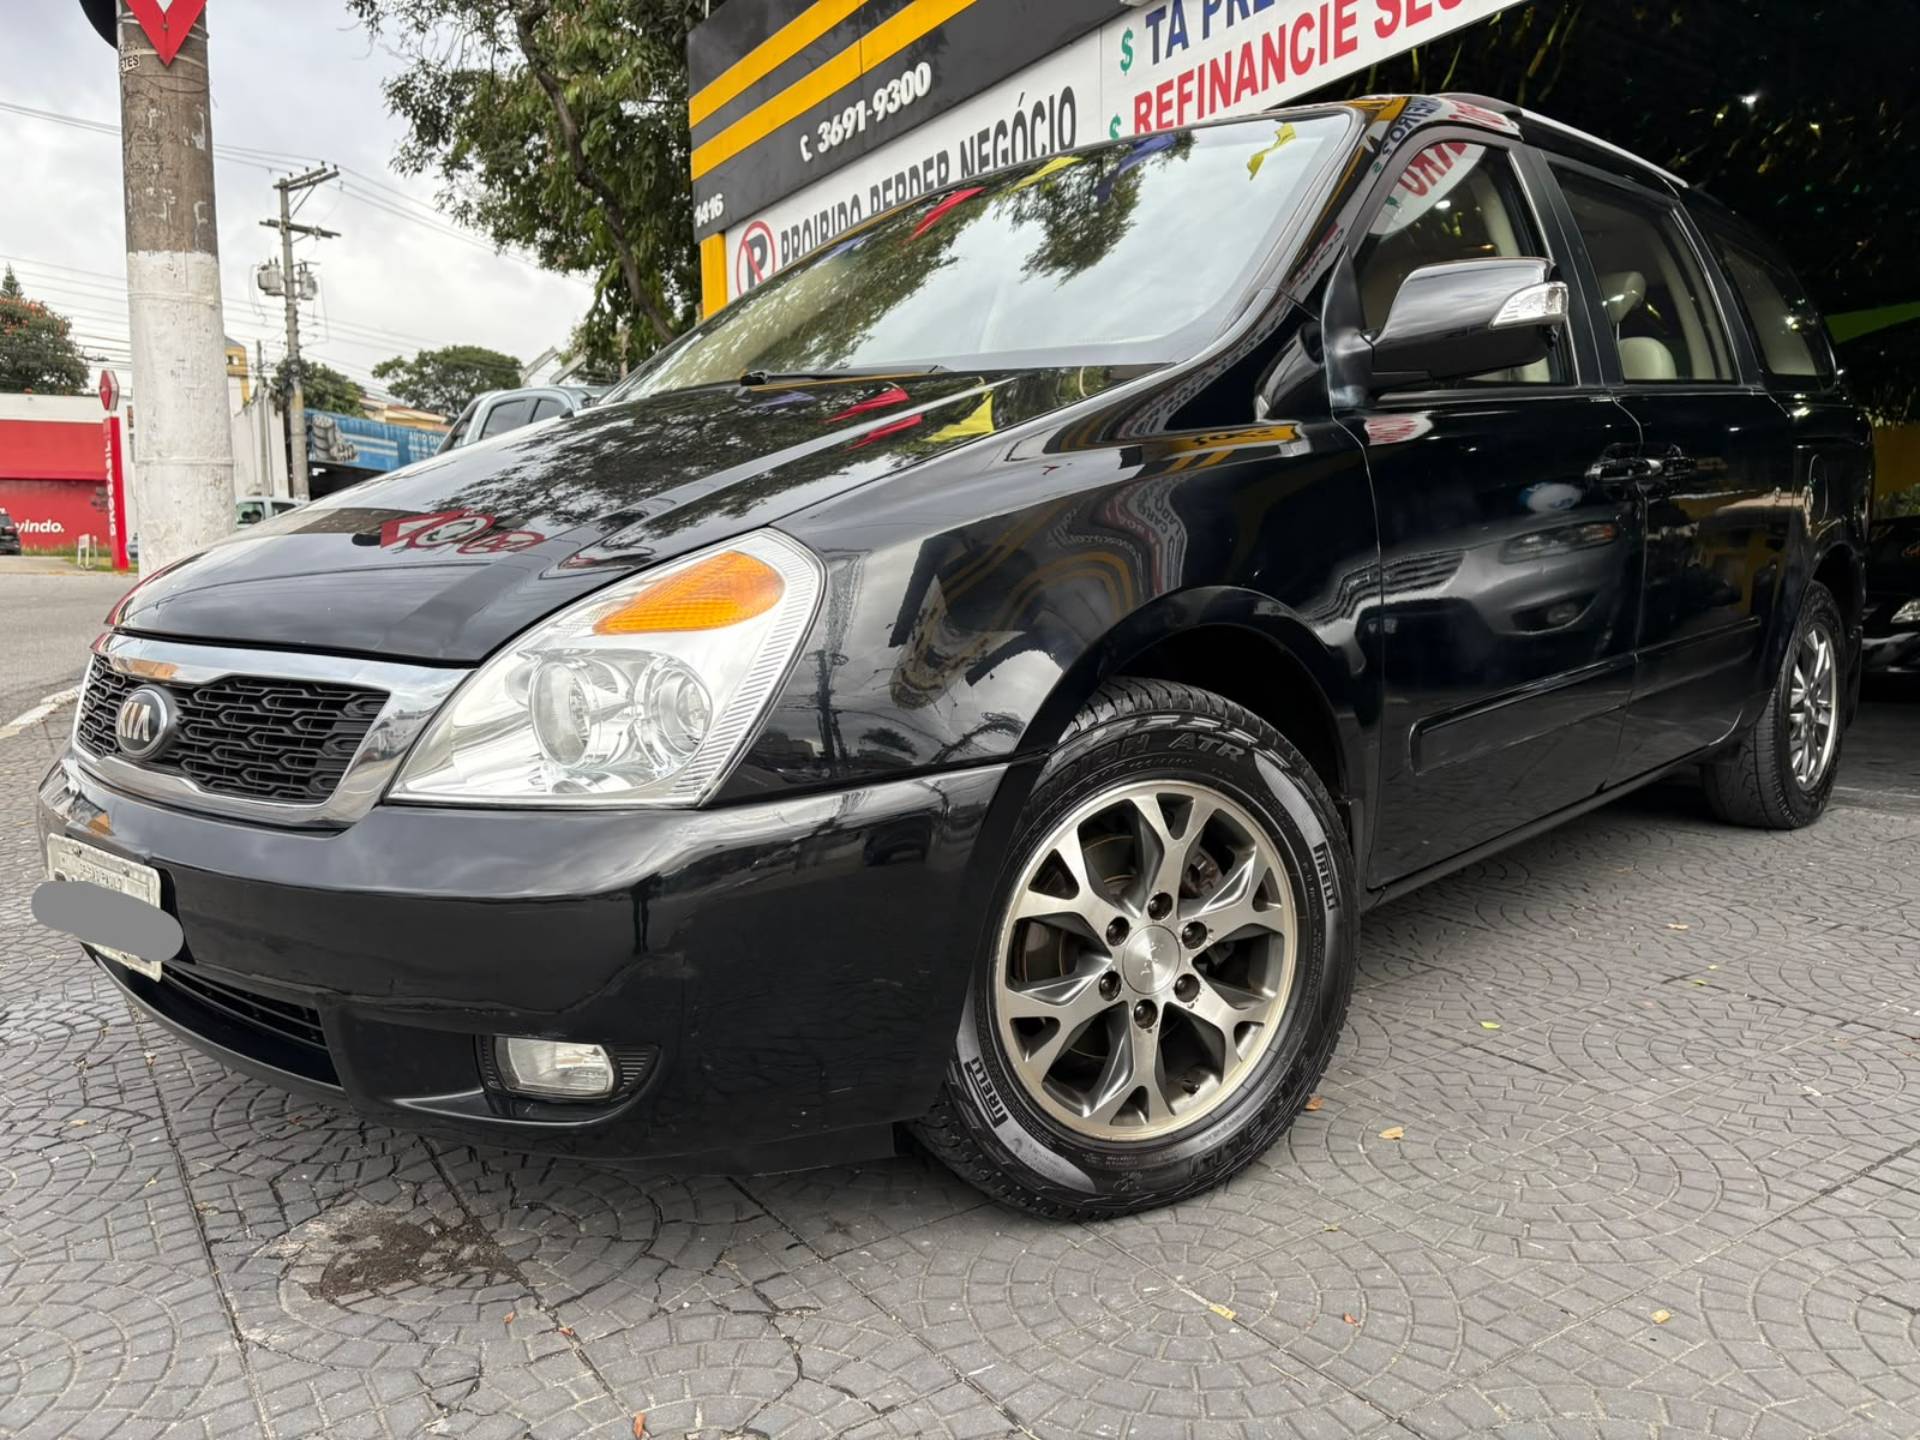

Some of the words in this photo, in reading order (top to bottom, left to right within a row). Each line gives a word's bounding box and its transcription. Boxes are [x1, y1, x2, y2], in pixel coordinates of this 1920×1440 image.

[1134, 0, 1358, 135] REFINANCIE
[1145, 0, 1190, 65] TA
[817, 61, 932, 153] 3691-9300
[694, 193, 724, 227] 1416
[781, 194, 861, 267] PROIBIDO
[959, 86, 1077, 179] NEGÓCIO
[104, 440, 117, 537] DROGASIL
[1167, 731, 1247, 763] ATR
[963, 1056, 1009, 1129] PIRELLI
